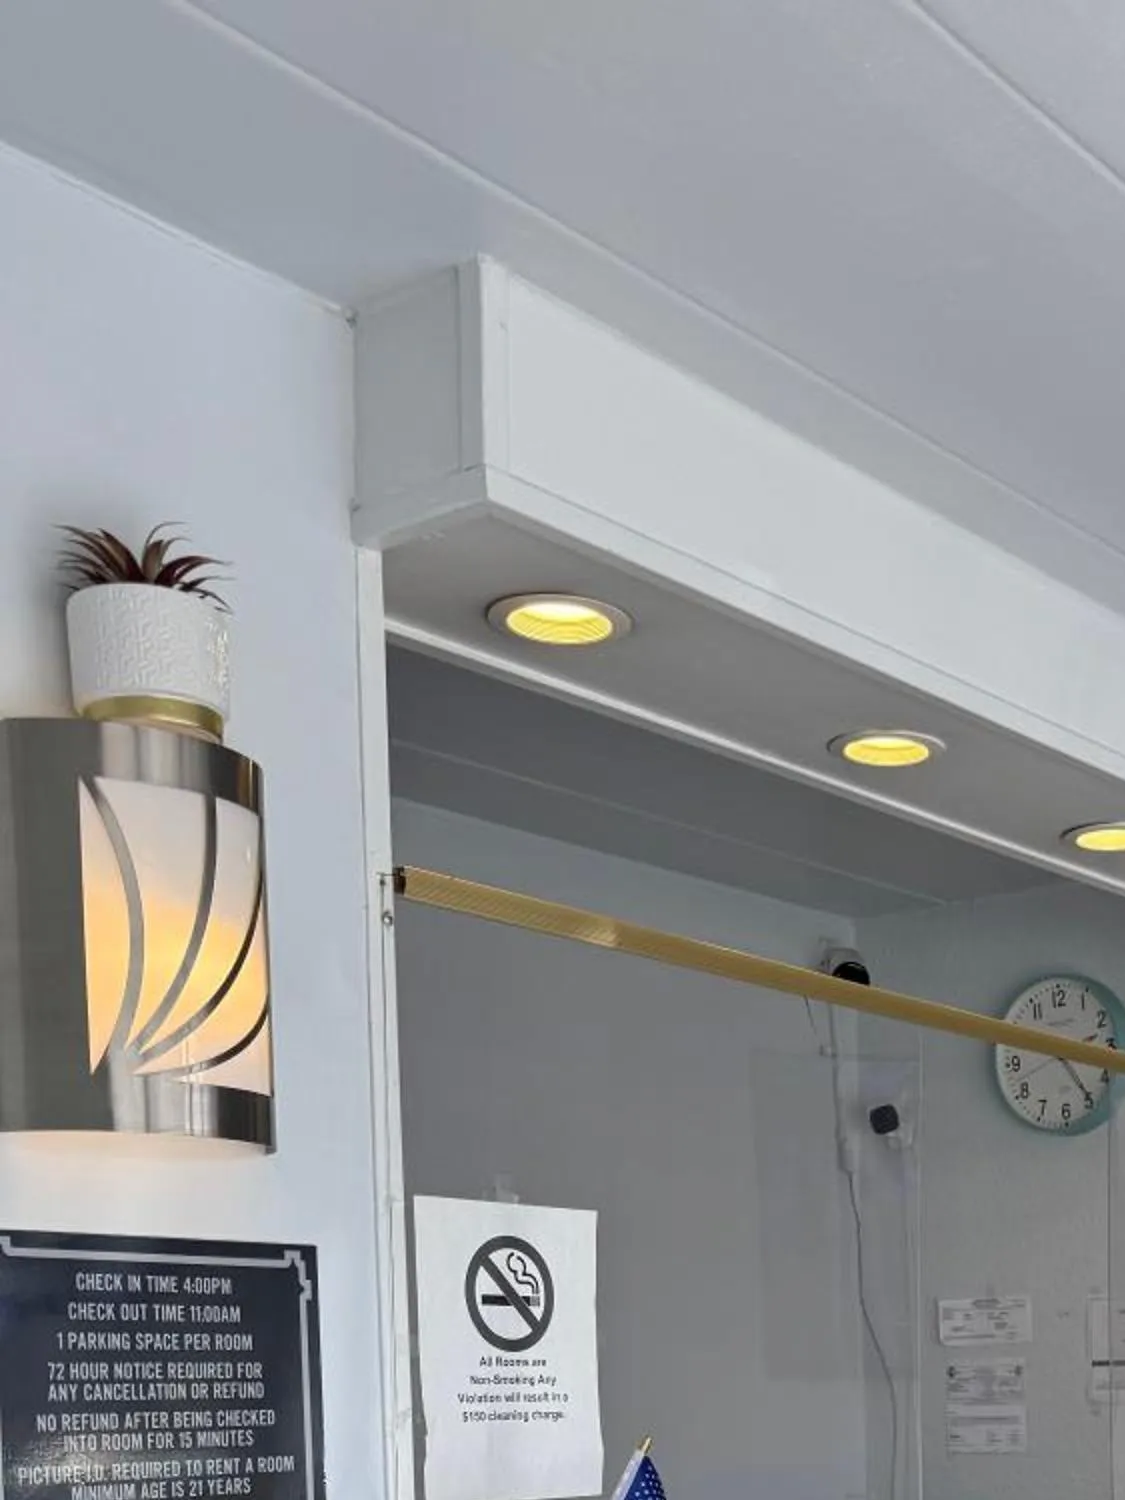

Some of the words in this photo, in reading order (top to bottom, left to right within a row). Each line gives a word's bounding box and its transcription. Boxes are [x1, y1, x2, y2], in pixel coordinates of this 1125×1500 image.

[1052, 989, 1066, 1008] 12
[1033, 1003, 1043, 1021] 11
[1096, 1010, 1106, 1029] 2
[1011, 1055, 1021, 1072] 9
[1019, 1082, 1029, 1100] 8
[1037, 1099, 1048, 1116] 7
[1061, 1103, 1071, 1120] 6
[75, 1272, 123, 1291] CHECK
[128, 1274, 141, 1292] IN
[146, 1275, 178, 1293] TIME
[183, 1276, 232, 1295] 4:00PM
[68, 1302, 115, 1321] CHECK
[120, 1303, 147, 1321] OUT
[152, 1304, 185, 1322] TIME
[57, 1333, 64, 1349] 1
[68, 1332, 131, 1350] PARKING
[135, 1333, 180, 1350] SPACE
[184, 1334, 210, 1350] PER
[215, 1334, 253, 1351] ROOM
[479, 1356, 493, 1367] All
[495, 1357, 529, 1367] Rooms
[531, 1359, 547, 1367] are
[48, 1362, 65, 1380] 72
[69, 1362, 109, 1380] HOUR
[113, 1362, 163, 1380] NOTICE
[167, 1362, 233, 1380] REQUIRED
[237, 1362, 263, 1379] FOR
[469, 1374, 535, 1387] Non-Smoking
[537, 1374, 557, 1387] Any
[48, 1383, 77, 1402] ANY
[83, 1382, 187, 1401] CANCELLATION
[191, 1382, 209, 1399] OR
[213, 1381, 265, 1399] REFUND
[457, 1393, 502, 1403] Violation
[36, 1414, 57, 1432] NO
[61, 1413, 119, 1431] REFUND
[124, 1411, 169, 1430] AFTER
[173, 1410, 213, 1428] BEING
[217, 1409, 276, 1427] CHECKED
[488, 1409, 529, 1423] cleaning
[63, 1434, 97, 1452] INTO
[101, 1433, 143, 1451] ROOM
[147, 1432, 174, 1449] FOR
[179, 1431, 193, 1448] 15
[197, 1430, 255, 1448] MINUTES
[18, 1465, 80, 1486] PICTURE
[111, 1461, 181, 1481] REQUIRED
[186, 1460, 201, 1477] TO
[205, 1458, 243, 1476] RENT
[245, 1458, 254, 1474] A
[257, 1455, 295, 1473] ROOM
[141, 1481, 168, 1499] AGE
[171, 1480, 184, 1498] IS
[188, 1480, 203, 1497] 21
[208, 1478, 251, 1496] YEARS
